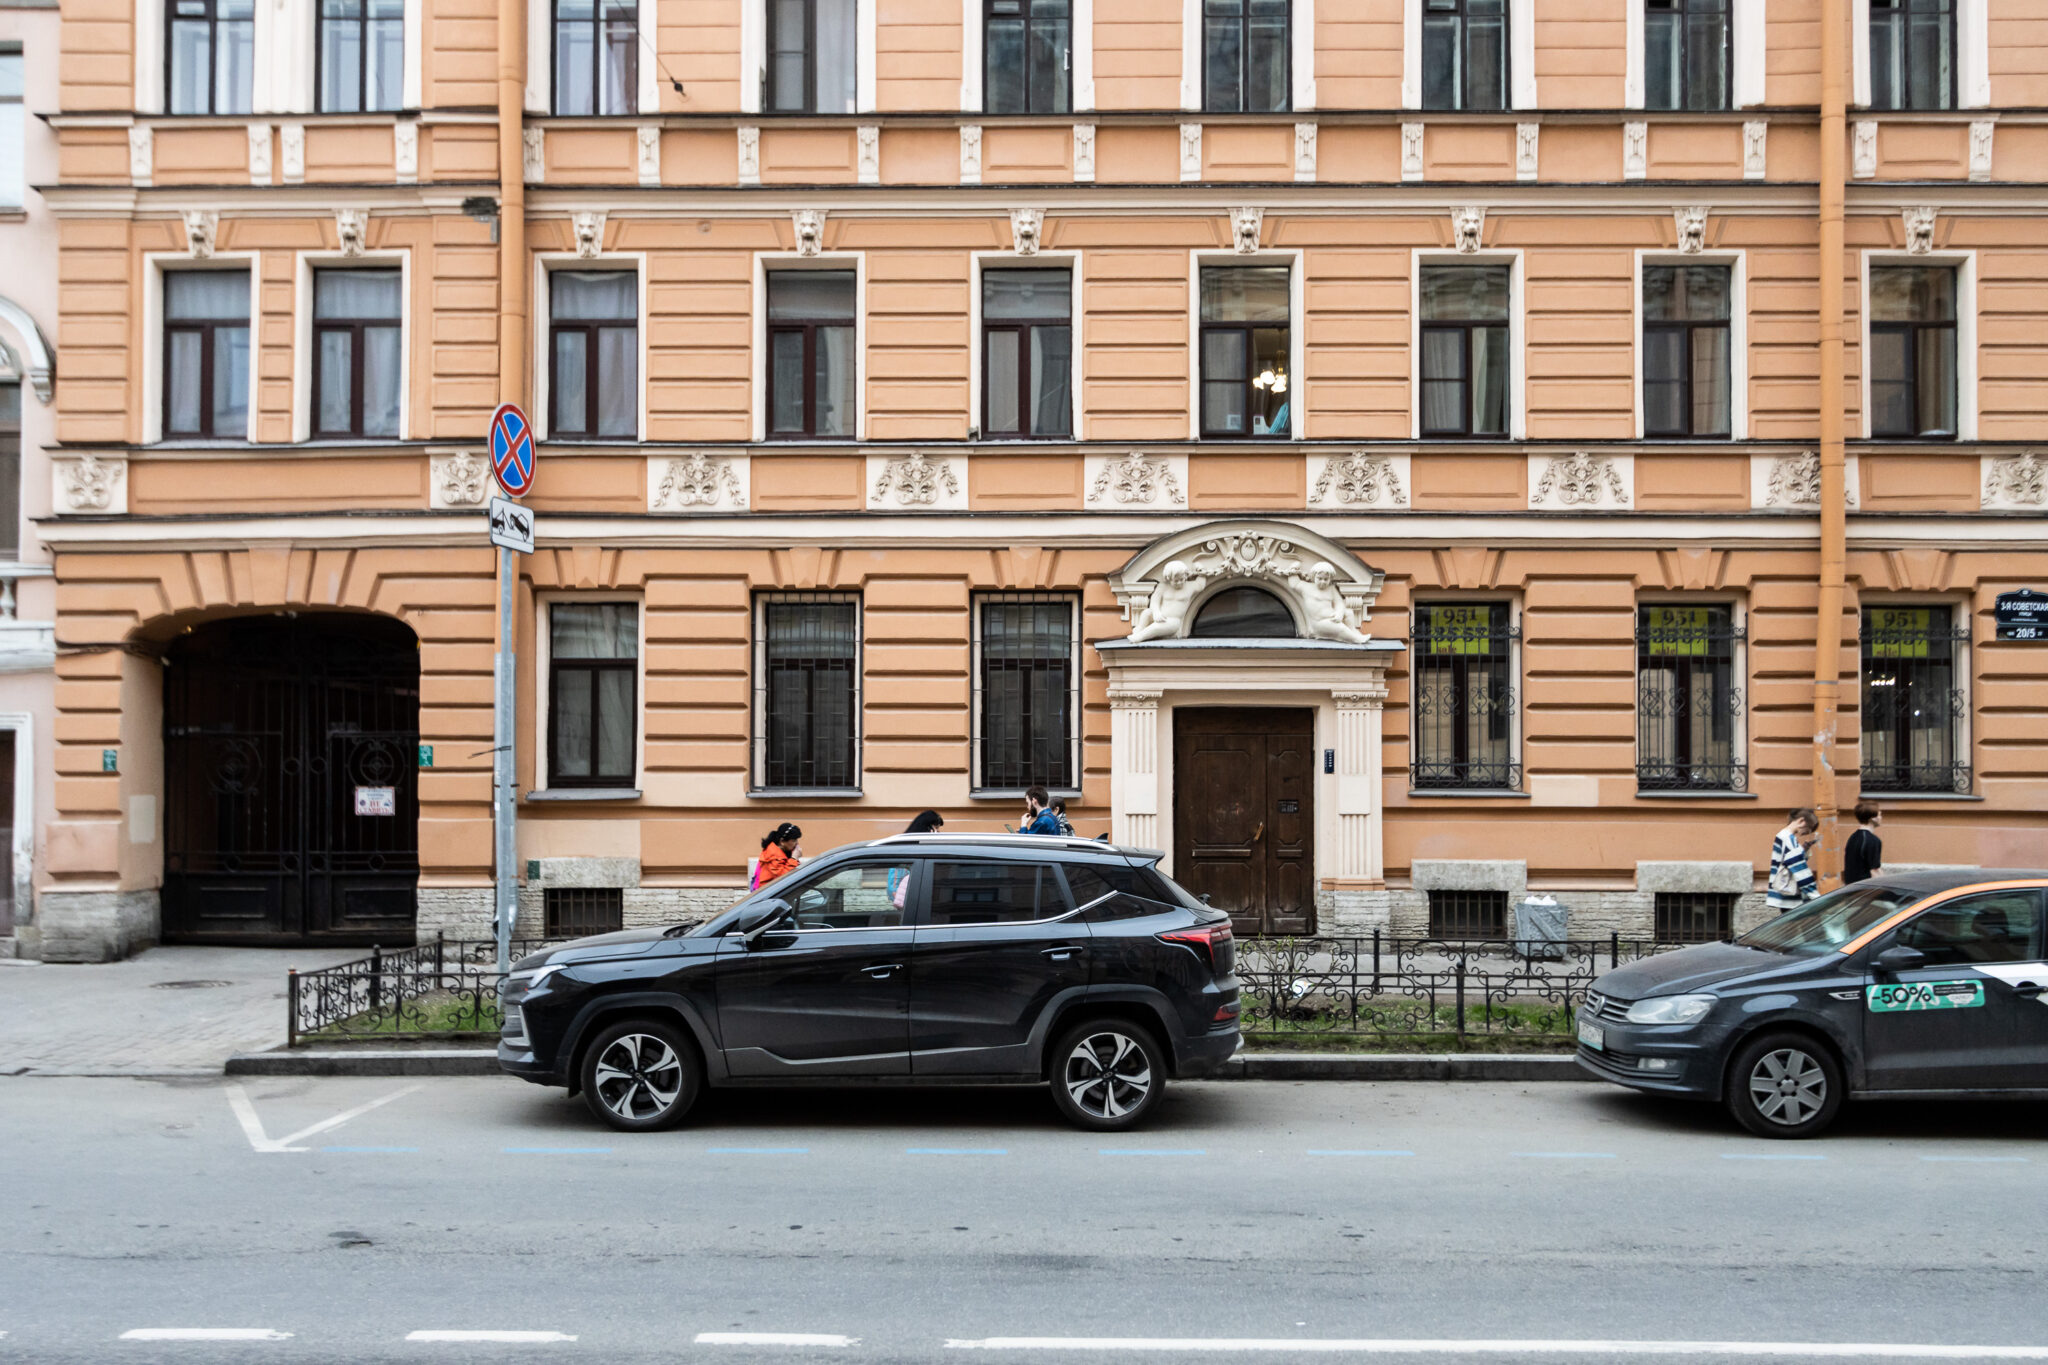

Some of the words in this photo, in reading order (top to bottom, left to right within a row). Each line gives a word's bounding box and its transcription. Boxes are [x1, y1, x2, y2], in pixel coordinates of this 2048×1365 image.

[1443, 609, 1477, 624] 951
[1663, 610, 1696, 626] 951
[1883, 611, 1917, 628] 951
[2016, 628, 2036, 638] 20/5
[1872, 986, 1932, 1004] -50%
